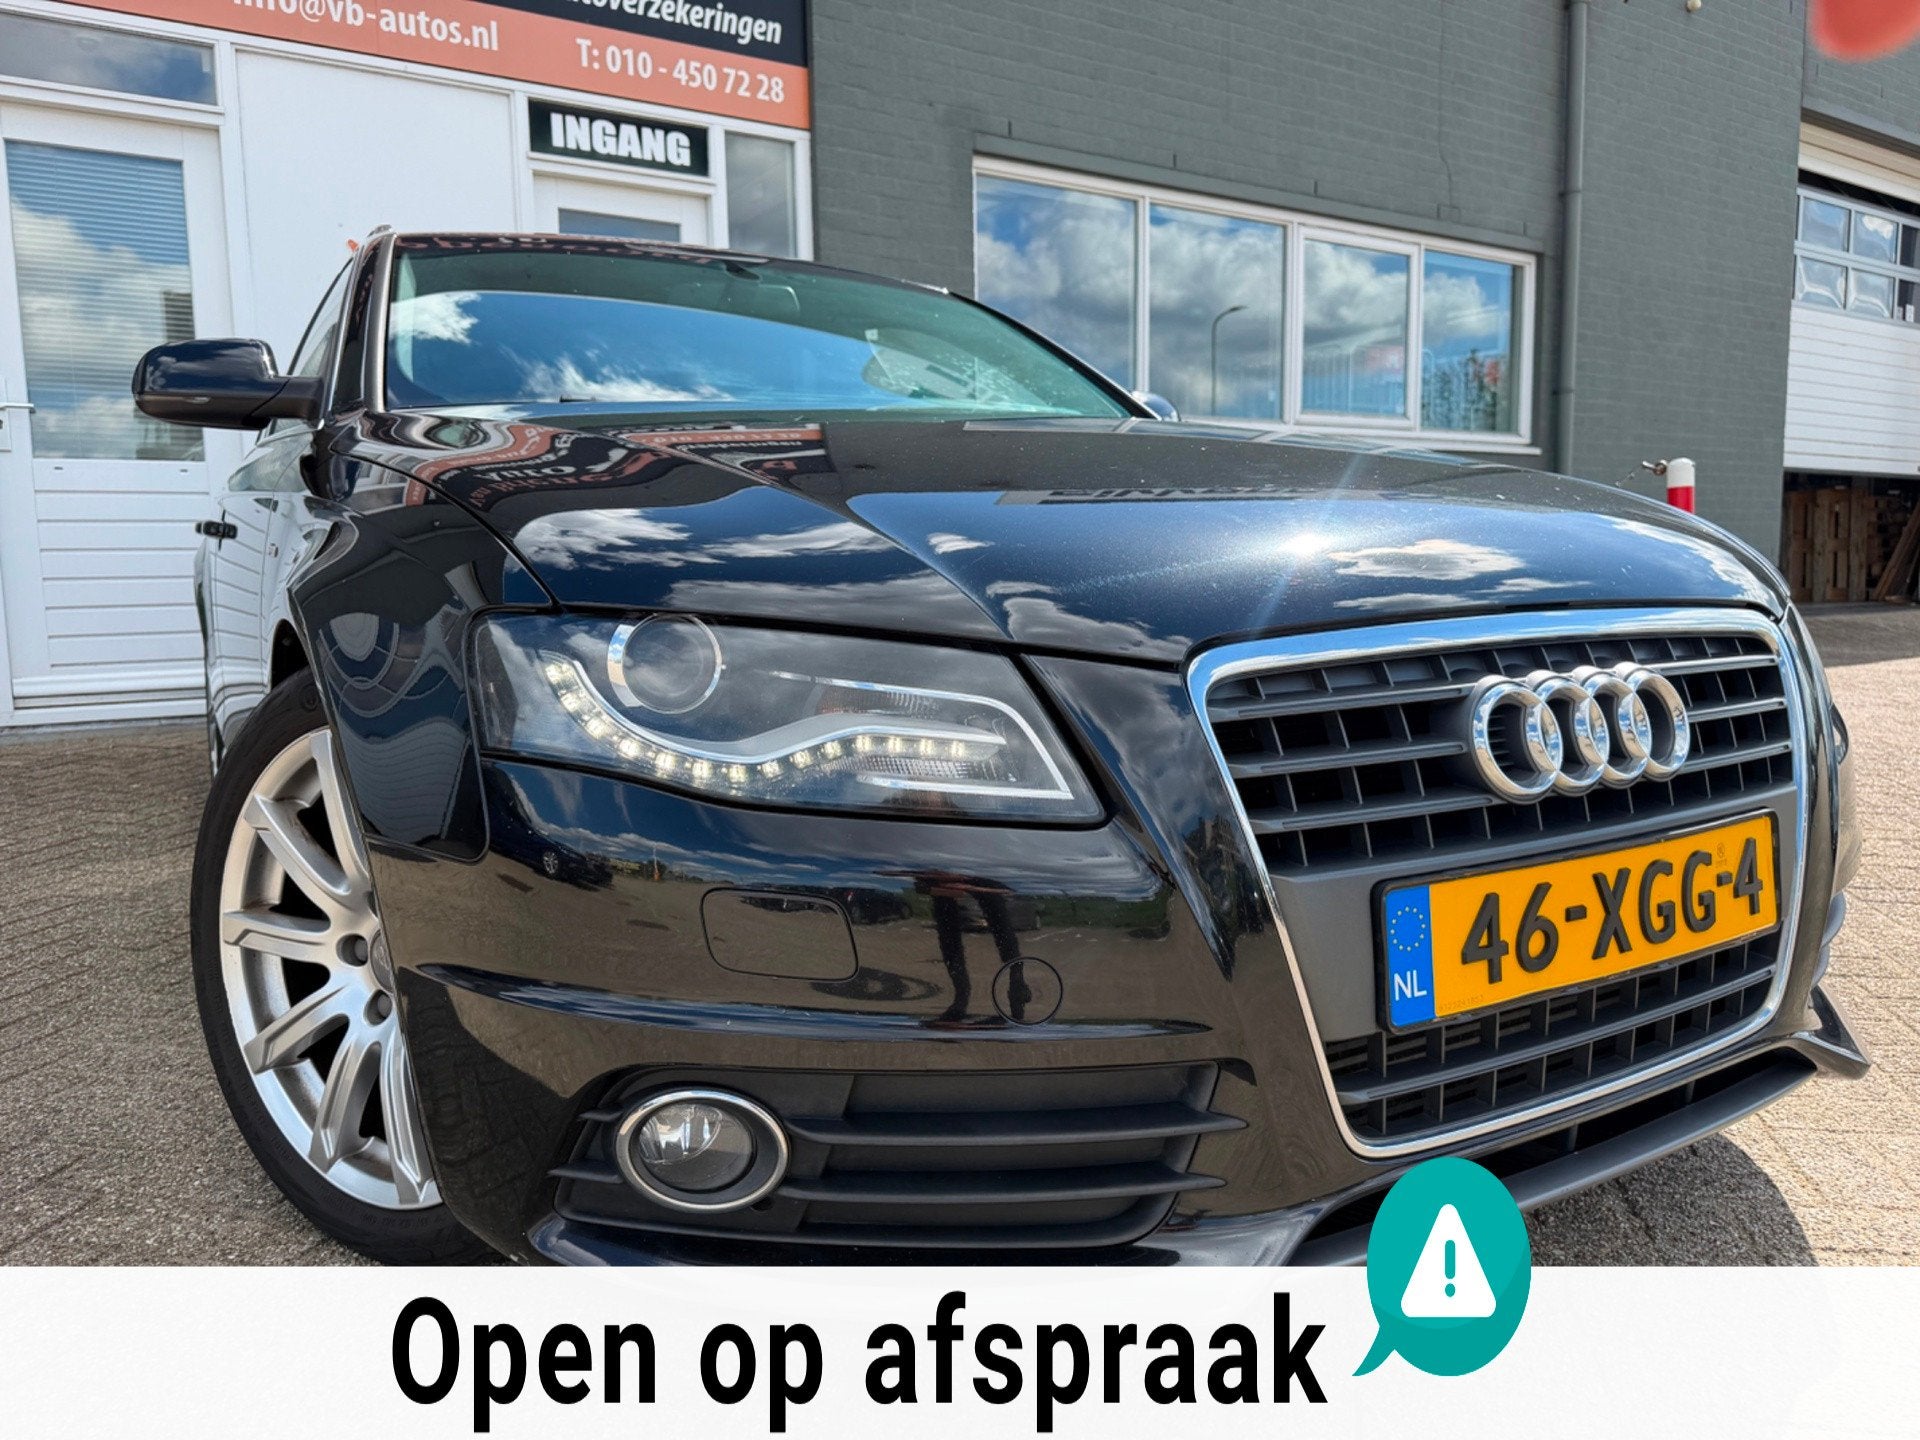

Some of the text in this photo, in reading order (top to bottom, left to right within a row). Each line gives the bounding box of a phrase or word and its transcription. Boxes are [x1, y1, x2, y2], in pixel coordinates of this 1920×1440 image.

[233, 0, 499, 51] o@vb-autos.nl
[567, 0, 782, 45] verzekeringen
[575, 37, 600, 70] T:
[605, 45, 653, 79] 010
[672, 58, 718, 91] 450
[722, 66, 751, 98] 72
[756, 73, 786, 104] 28
[550, 112, 692, 167] INGANG
[1460, 837, 1764, 985] 46-XGG-4
[1393, 969, 1428, 1002] NL
